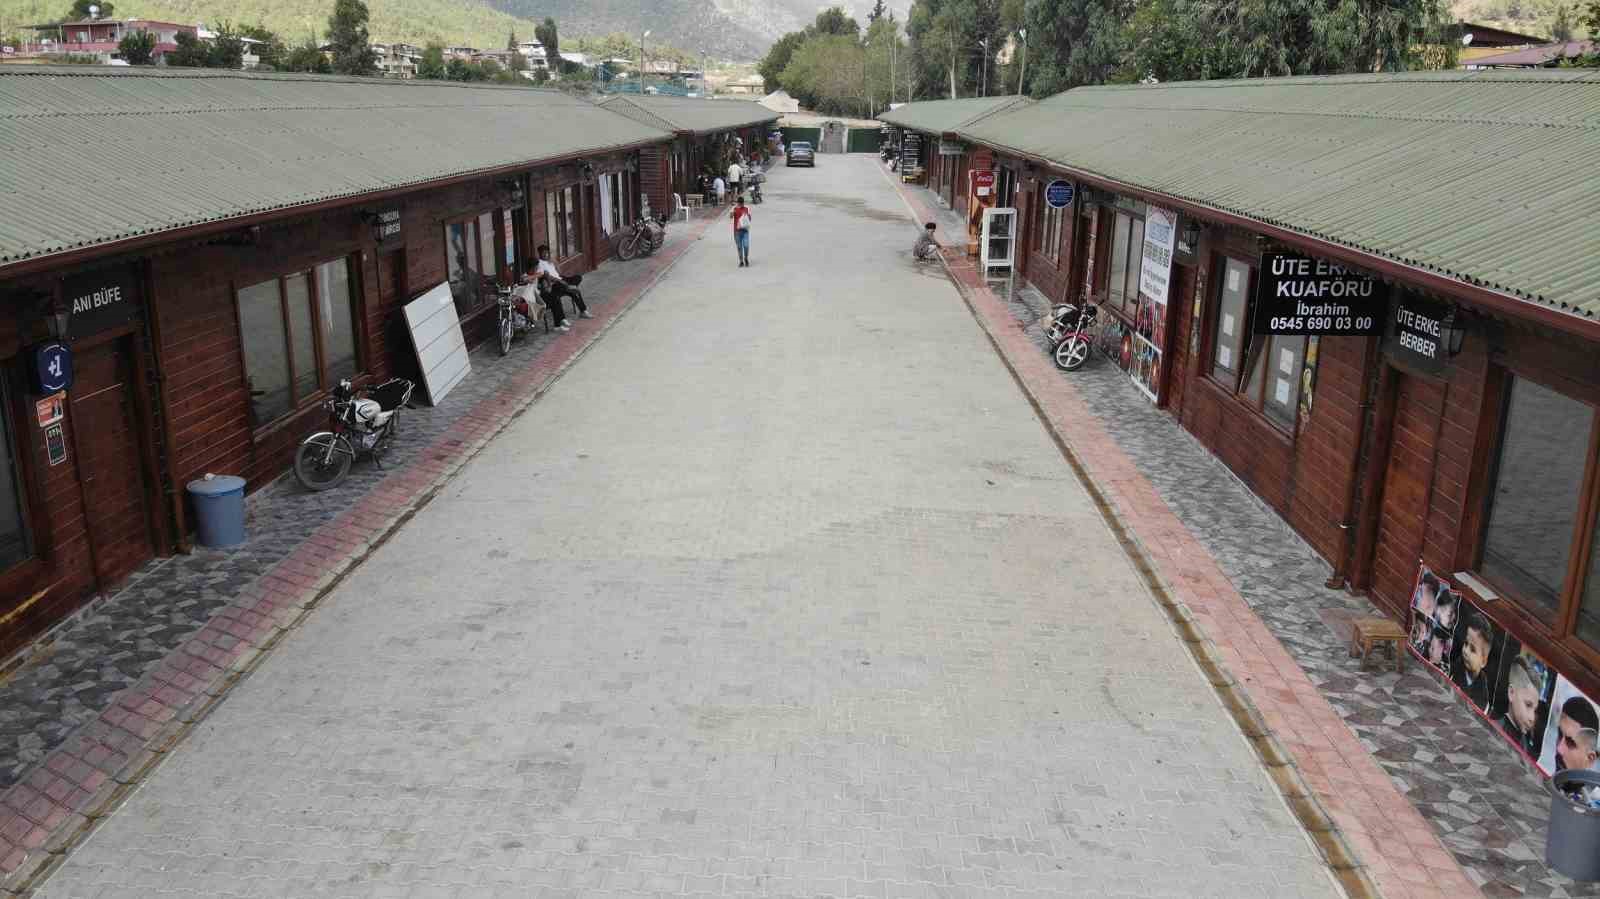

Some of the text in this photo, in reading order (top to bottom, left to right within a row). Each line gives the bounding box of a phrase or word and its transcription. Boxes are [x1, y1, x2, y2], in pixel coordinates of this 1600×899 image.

[1272, 256, 1311, 275] ÜTE
[1276, 278, 1373, 297] KUAFÖRÜ
[72, 286, 121, 314] ANI BÜFE
[1296, 300, 1349, 316] İbrahim
[1270, 316, 1372, 330] 0545 690 03 00
[1397, 305, 1441, 338] ÜTE ERKE
[1400, 330, 1436, 359] BERBER
